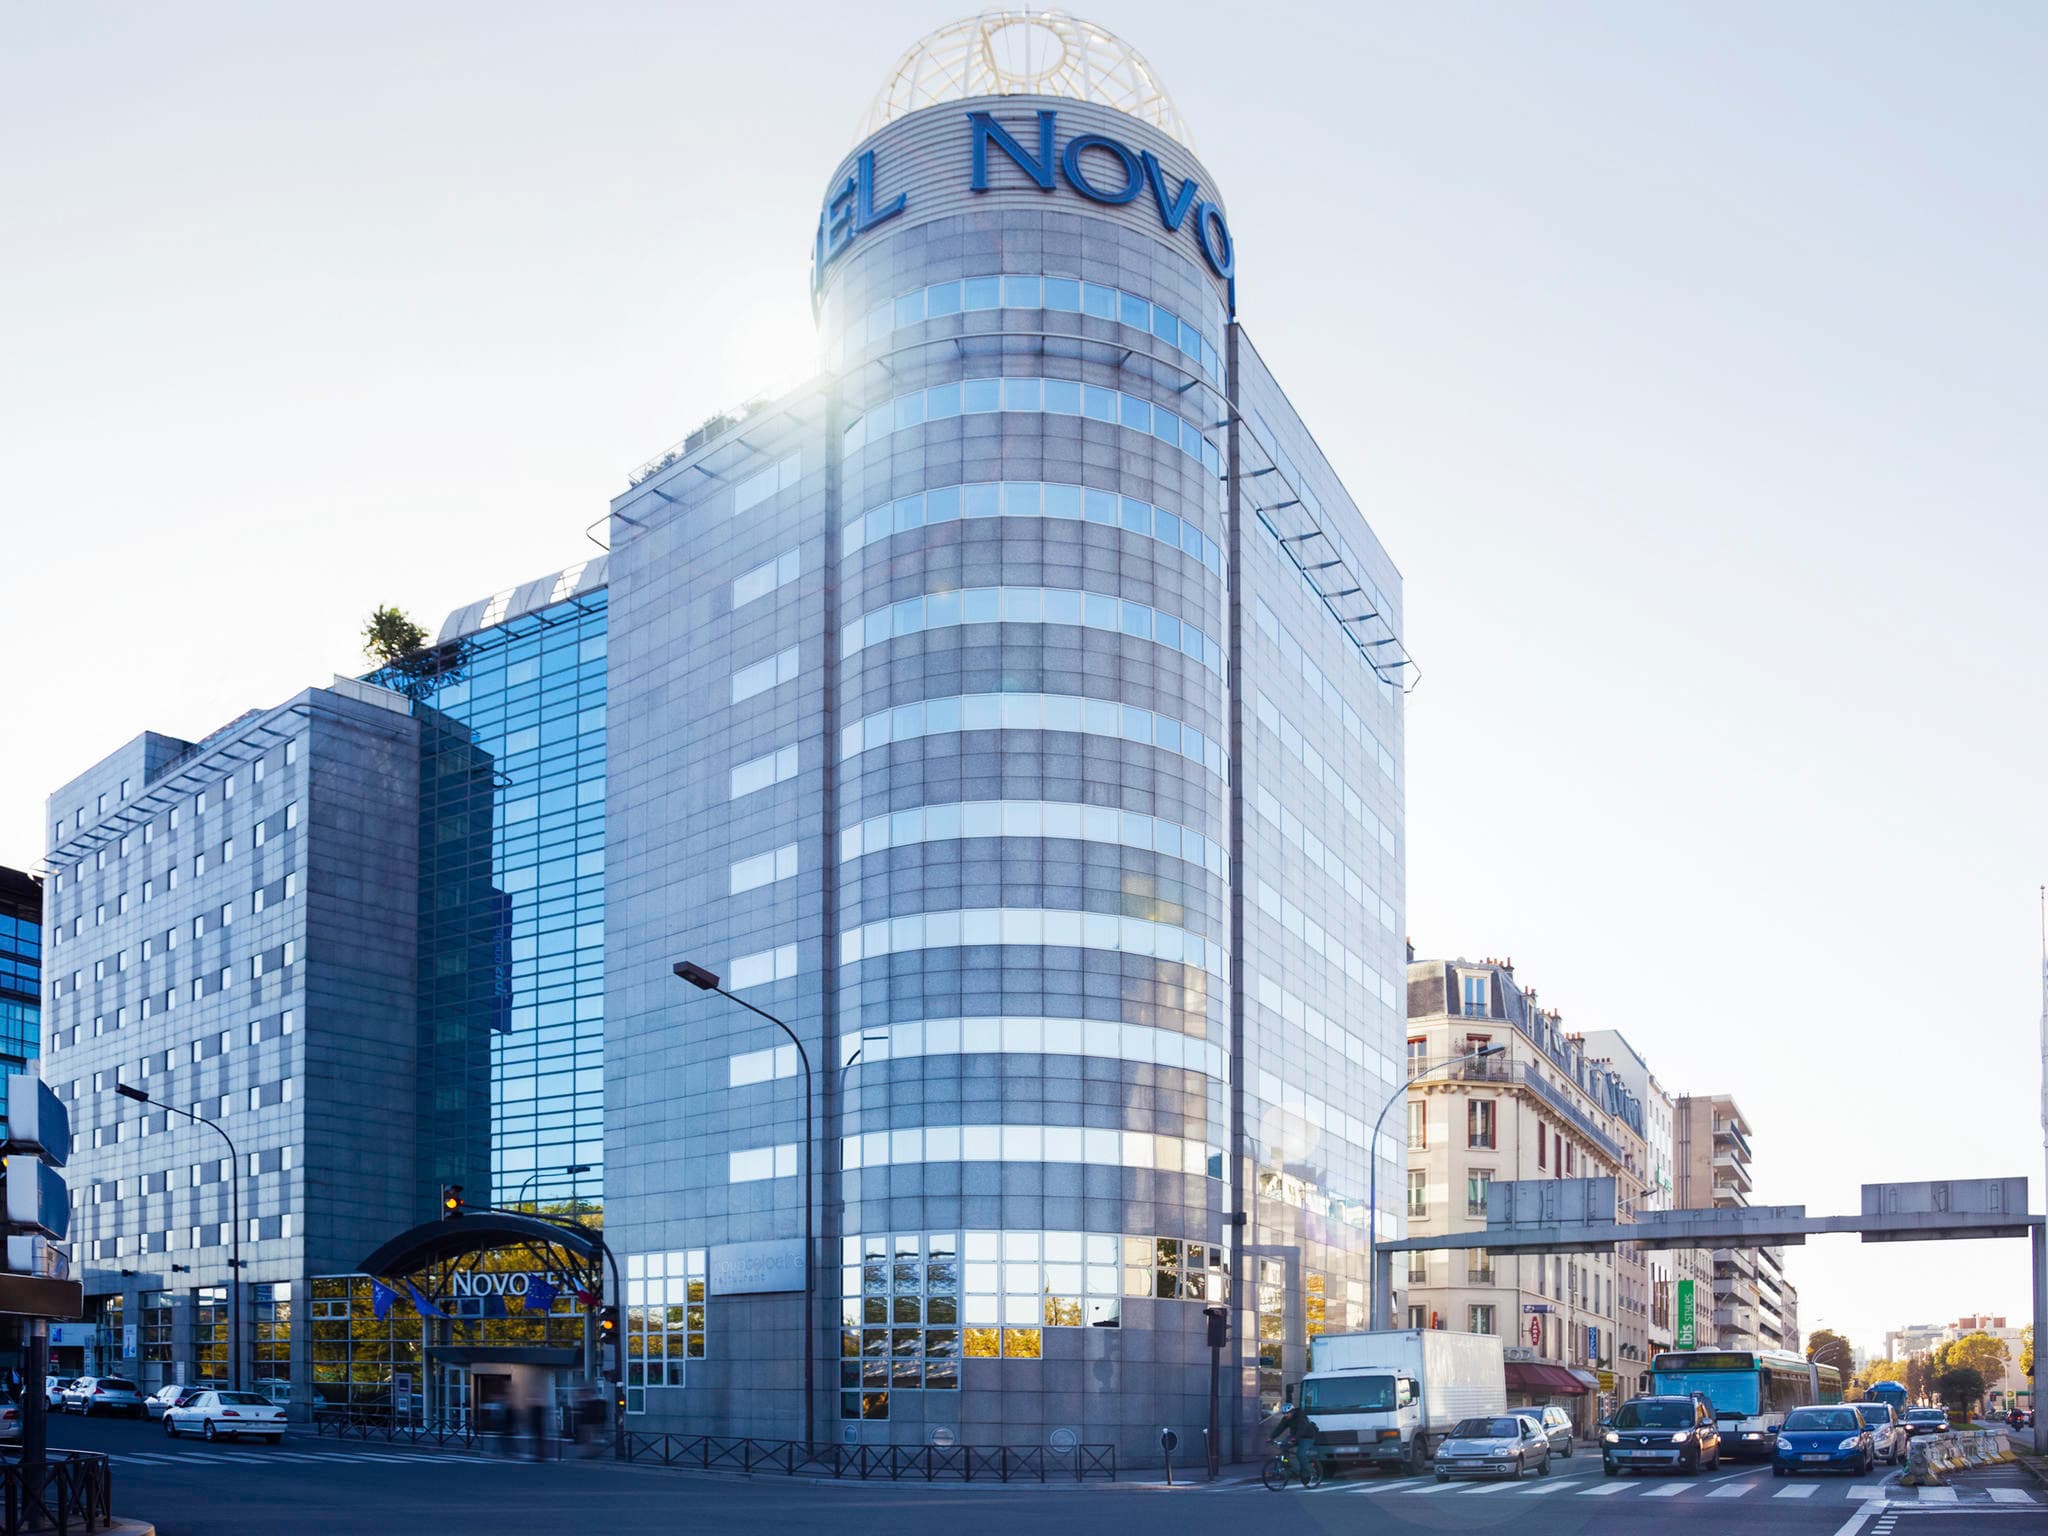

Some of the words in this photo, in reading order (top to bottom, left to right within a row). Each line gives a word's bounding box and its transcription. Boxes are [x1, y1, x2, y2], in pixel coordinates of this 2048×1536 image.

[816, 150, 907, 290] EL
[965, 109, 1236, 318] NOVO
[453, 1270, 578, 1297] NOVOEL
[1530, 1319, 1539, 1343] TABAC
[1679, 1323, 1693, 1345] ibis
